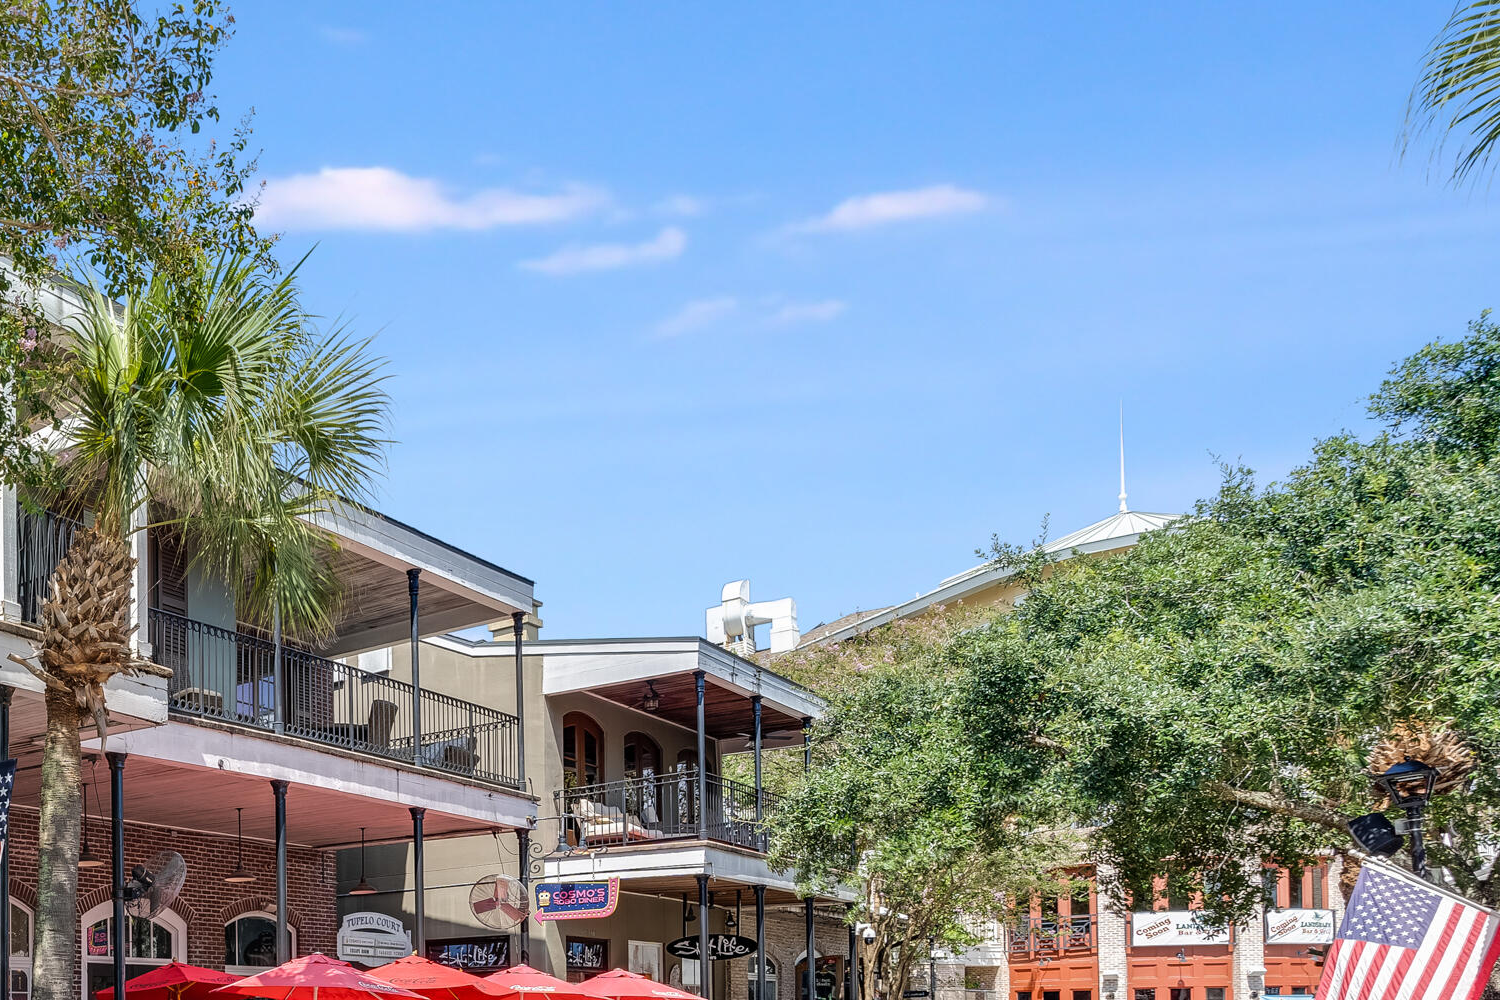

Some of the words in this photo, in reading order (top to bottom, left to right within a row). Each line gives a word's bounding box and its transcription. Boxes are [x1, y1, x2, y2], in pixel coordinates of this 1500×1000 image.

[552, 888, 606, 900] COSMO'S
[553, 898, 577, 906] ROBO
[578, 896, 605, 904] DINER
[346, 917, 374, 928] TUPELO
[376, 918, 400, 933] COURT
[1136, 918, 1172, 936] Coming
[1270, 916, 1298, 933] Coming
[1277, 924, 1297, 937] Soon
[1145, 926, 1170, 940] Soon
[716, 935, 750, 956] Life
